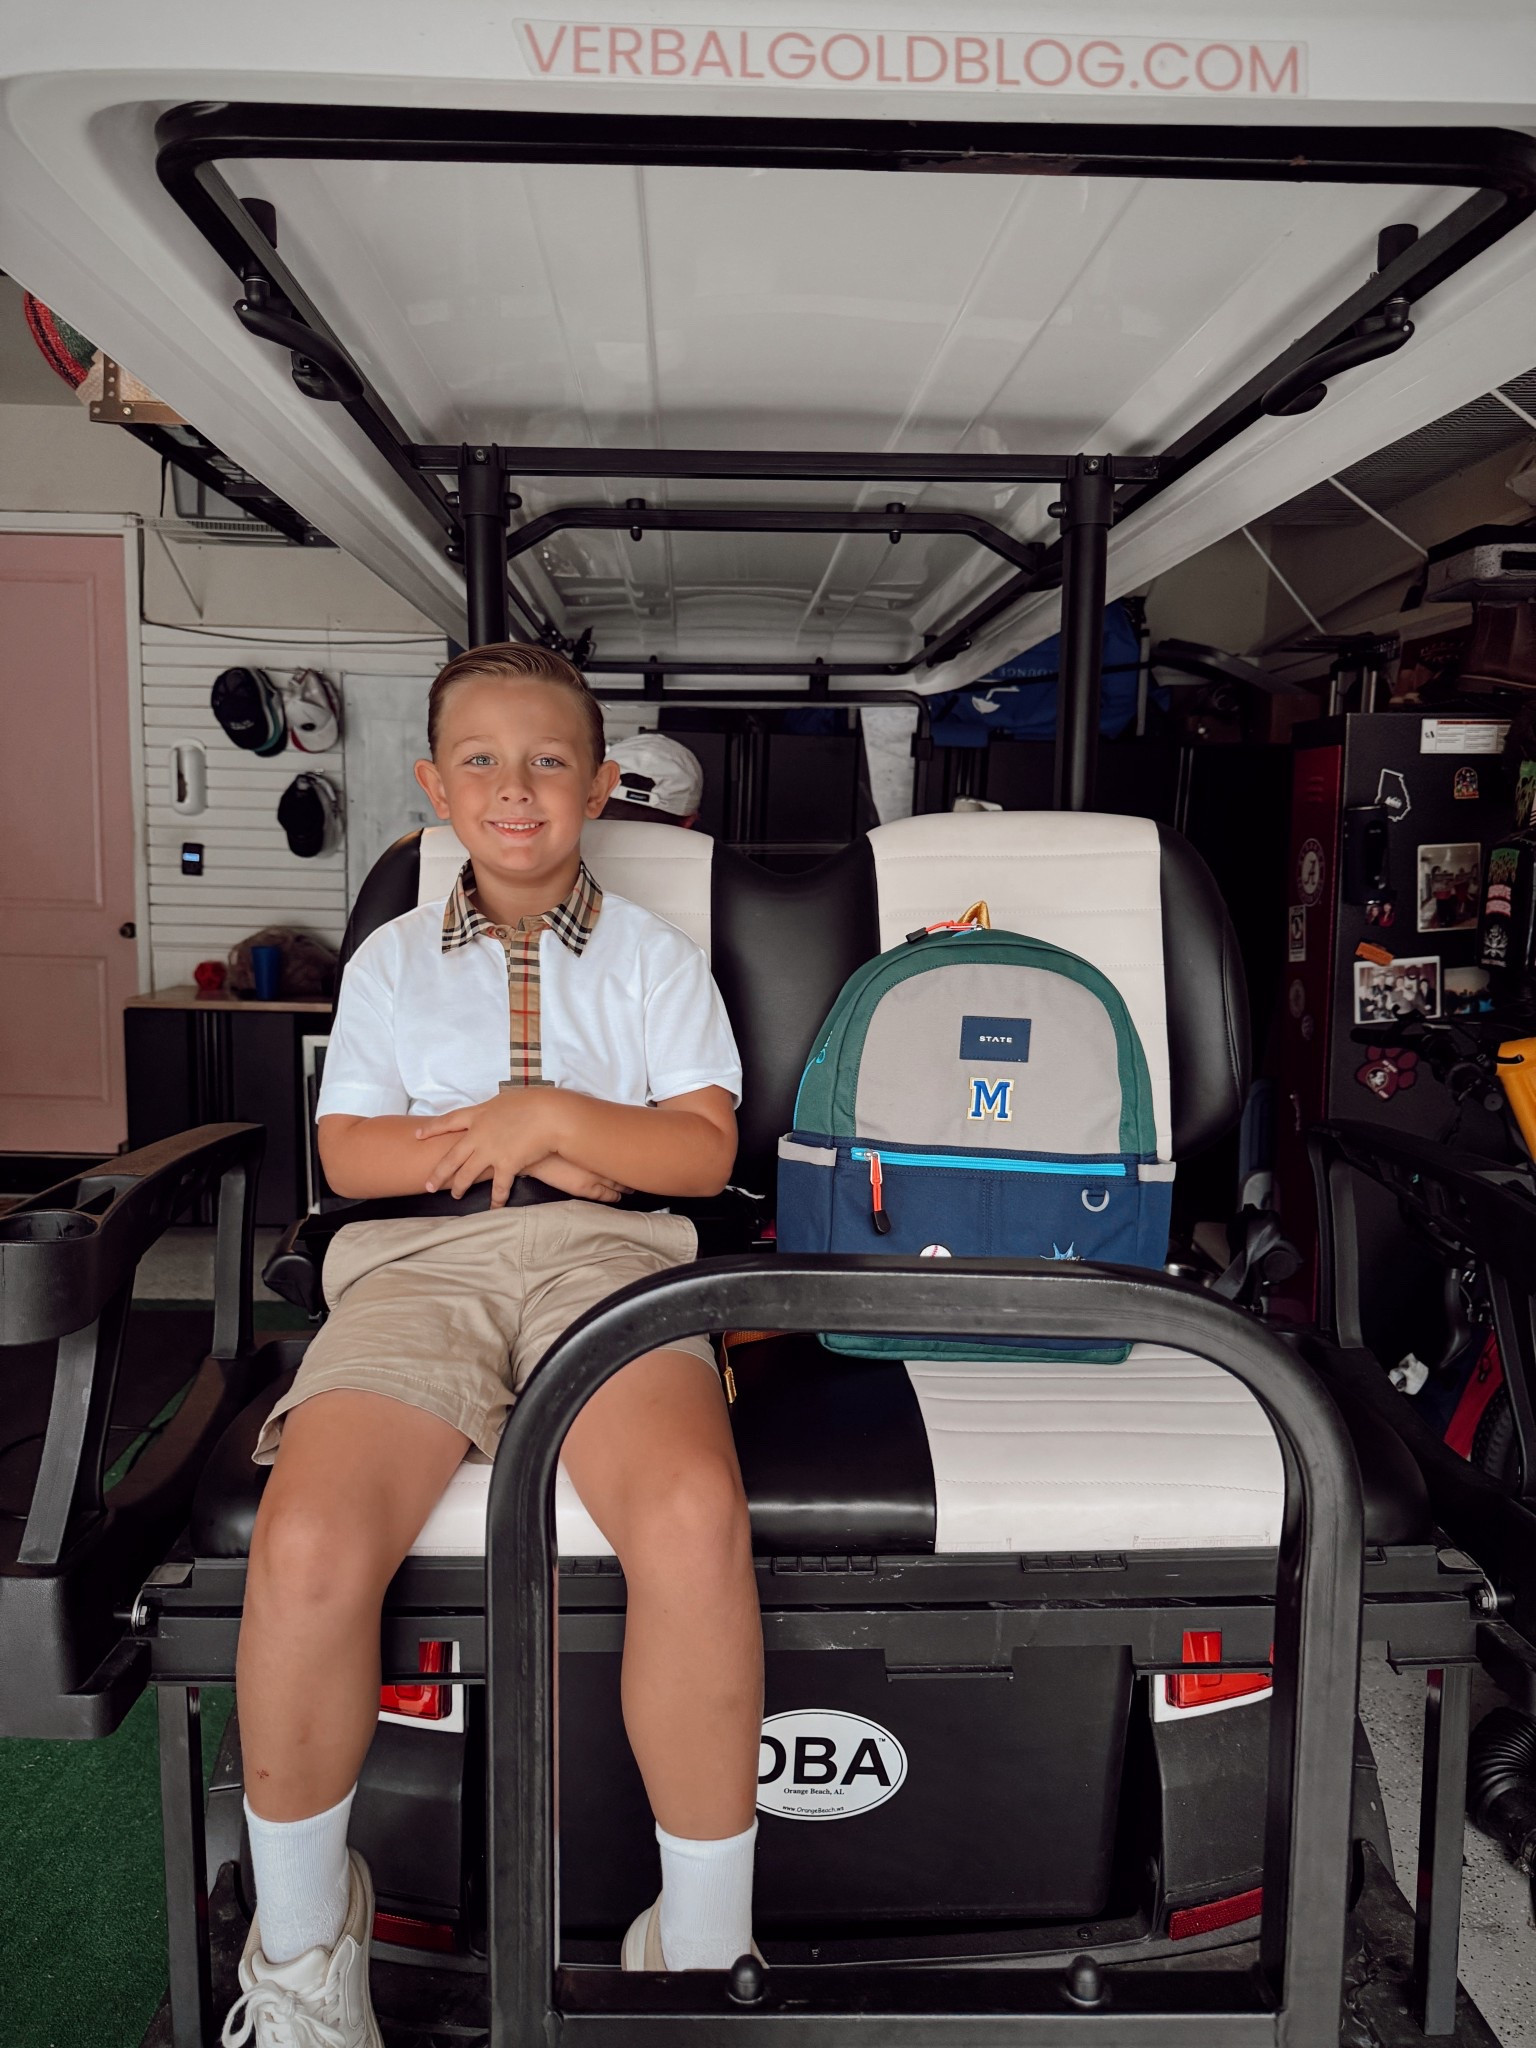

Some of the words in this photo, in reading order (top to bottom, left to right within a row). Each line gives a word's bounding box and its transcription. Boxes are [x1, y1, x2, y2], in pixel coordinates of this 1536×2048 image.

[522, 24, 1300, 93] VERBALGOLDBLOG.COM
[979, 1035, 1013, 1043] STATE
[968, 1077, 1014, 1121] M
[783, 1788, 809, 1796] Orange
[810, 1788, 832, 1796] Beach,
